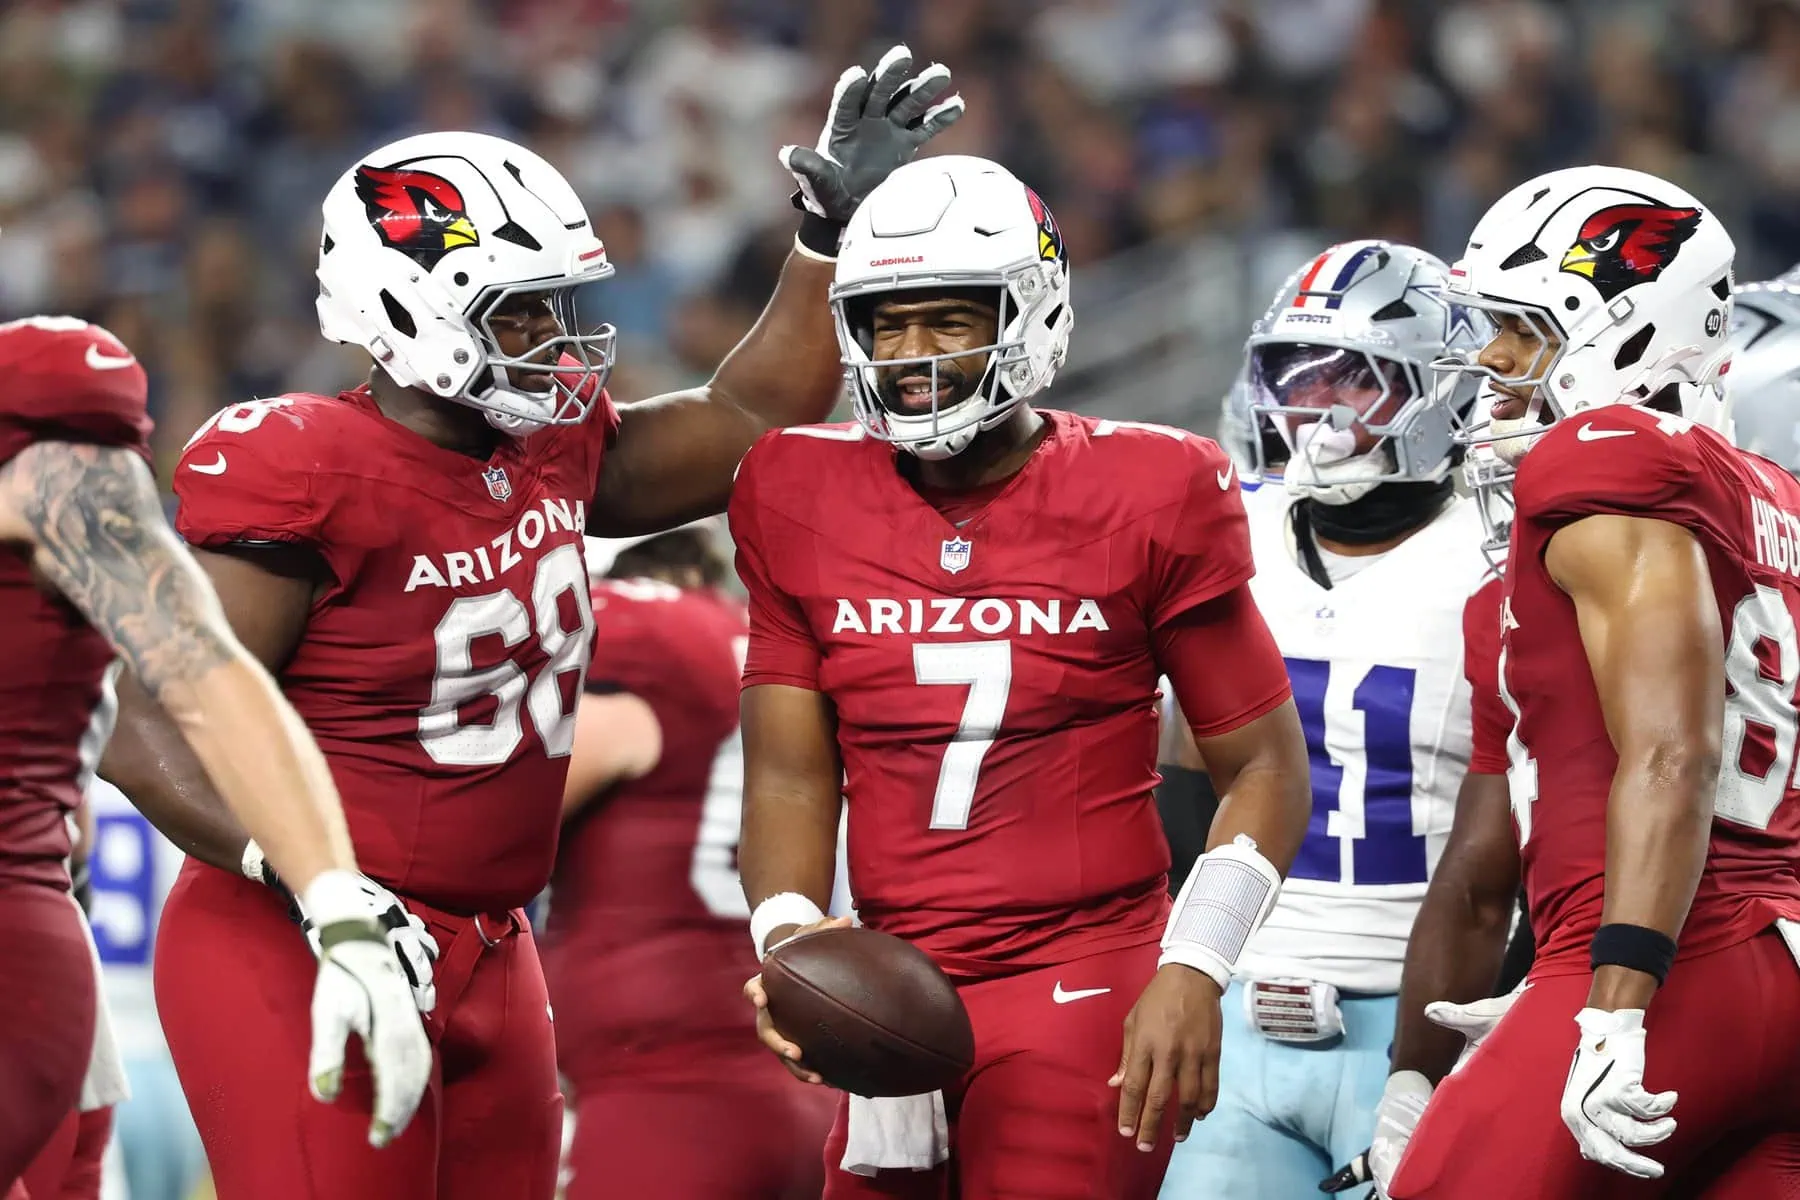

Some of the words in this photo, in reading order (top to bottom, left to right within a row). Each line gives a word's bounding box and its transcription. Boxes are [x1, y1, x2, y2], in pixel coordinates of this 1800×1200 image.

[869, 255, 924, 267] CARDINALS
[416, 542, 598, 766] 68
[832, 598, 1111, 635] ARIZONA
[912, 639, 1013, 830] 7
